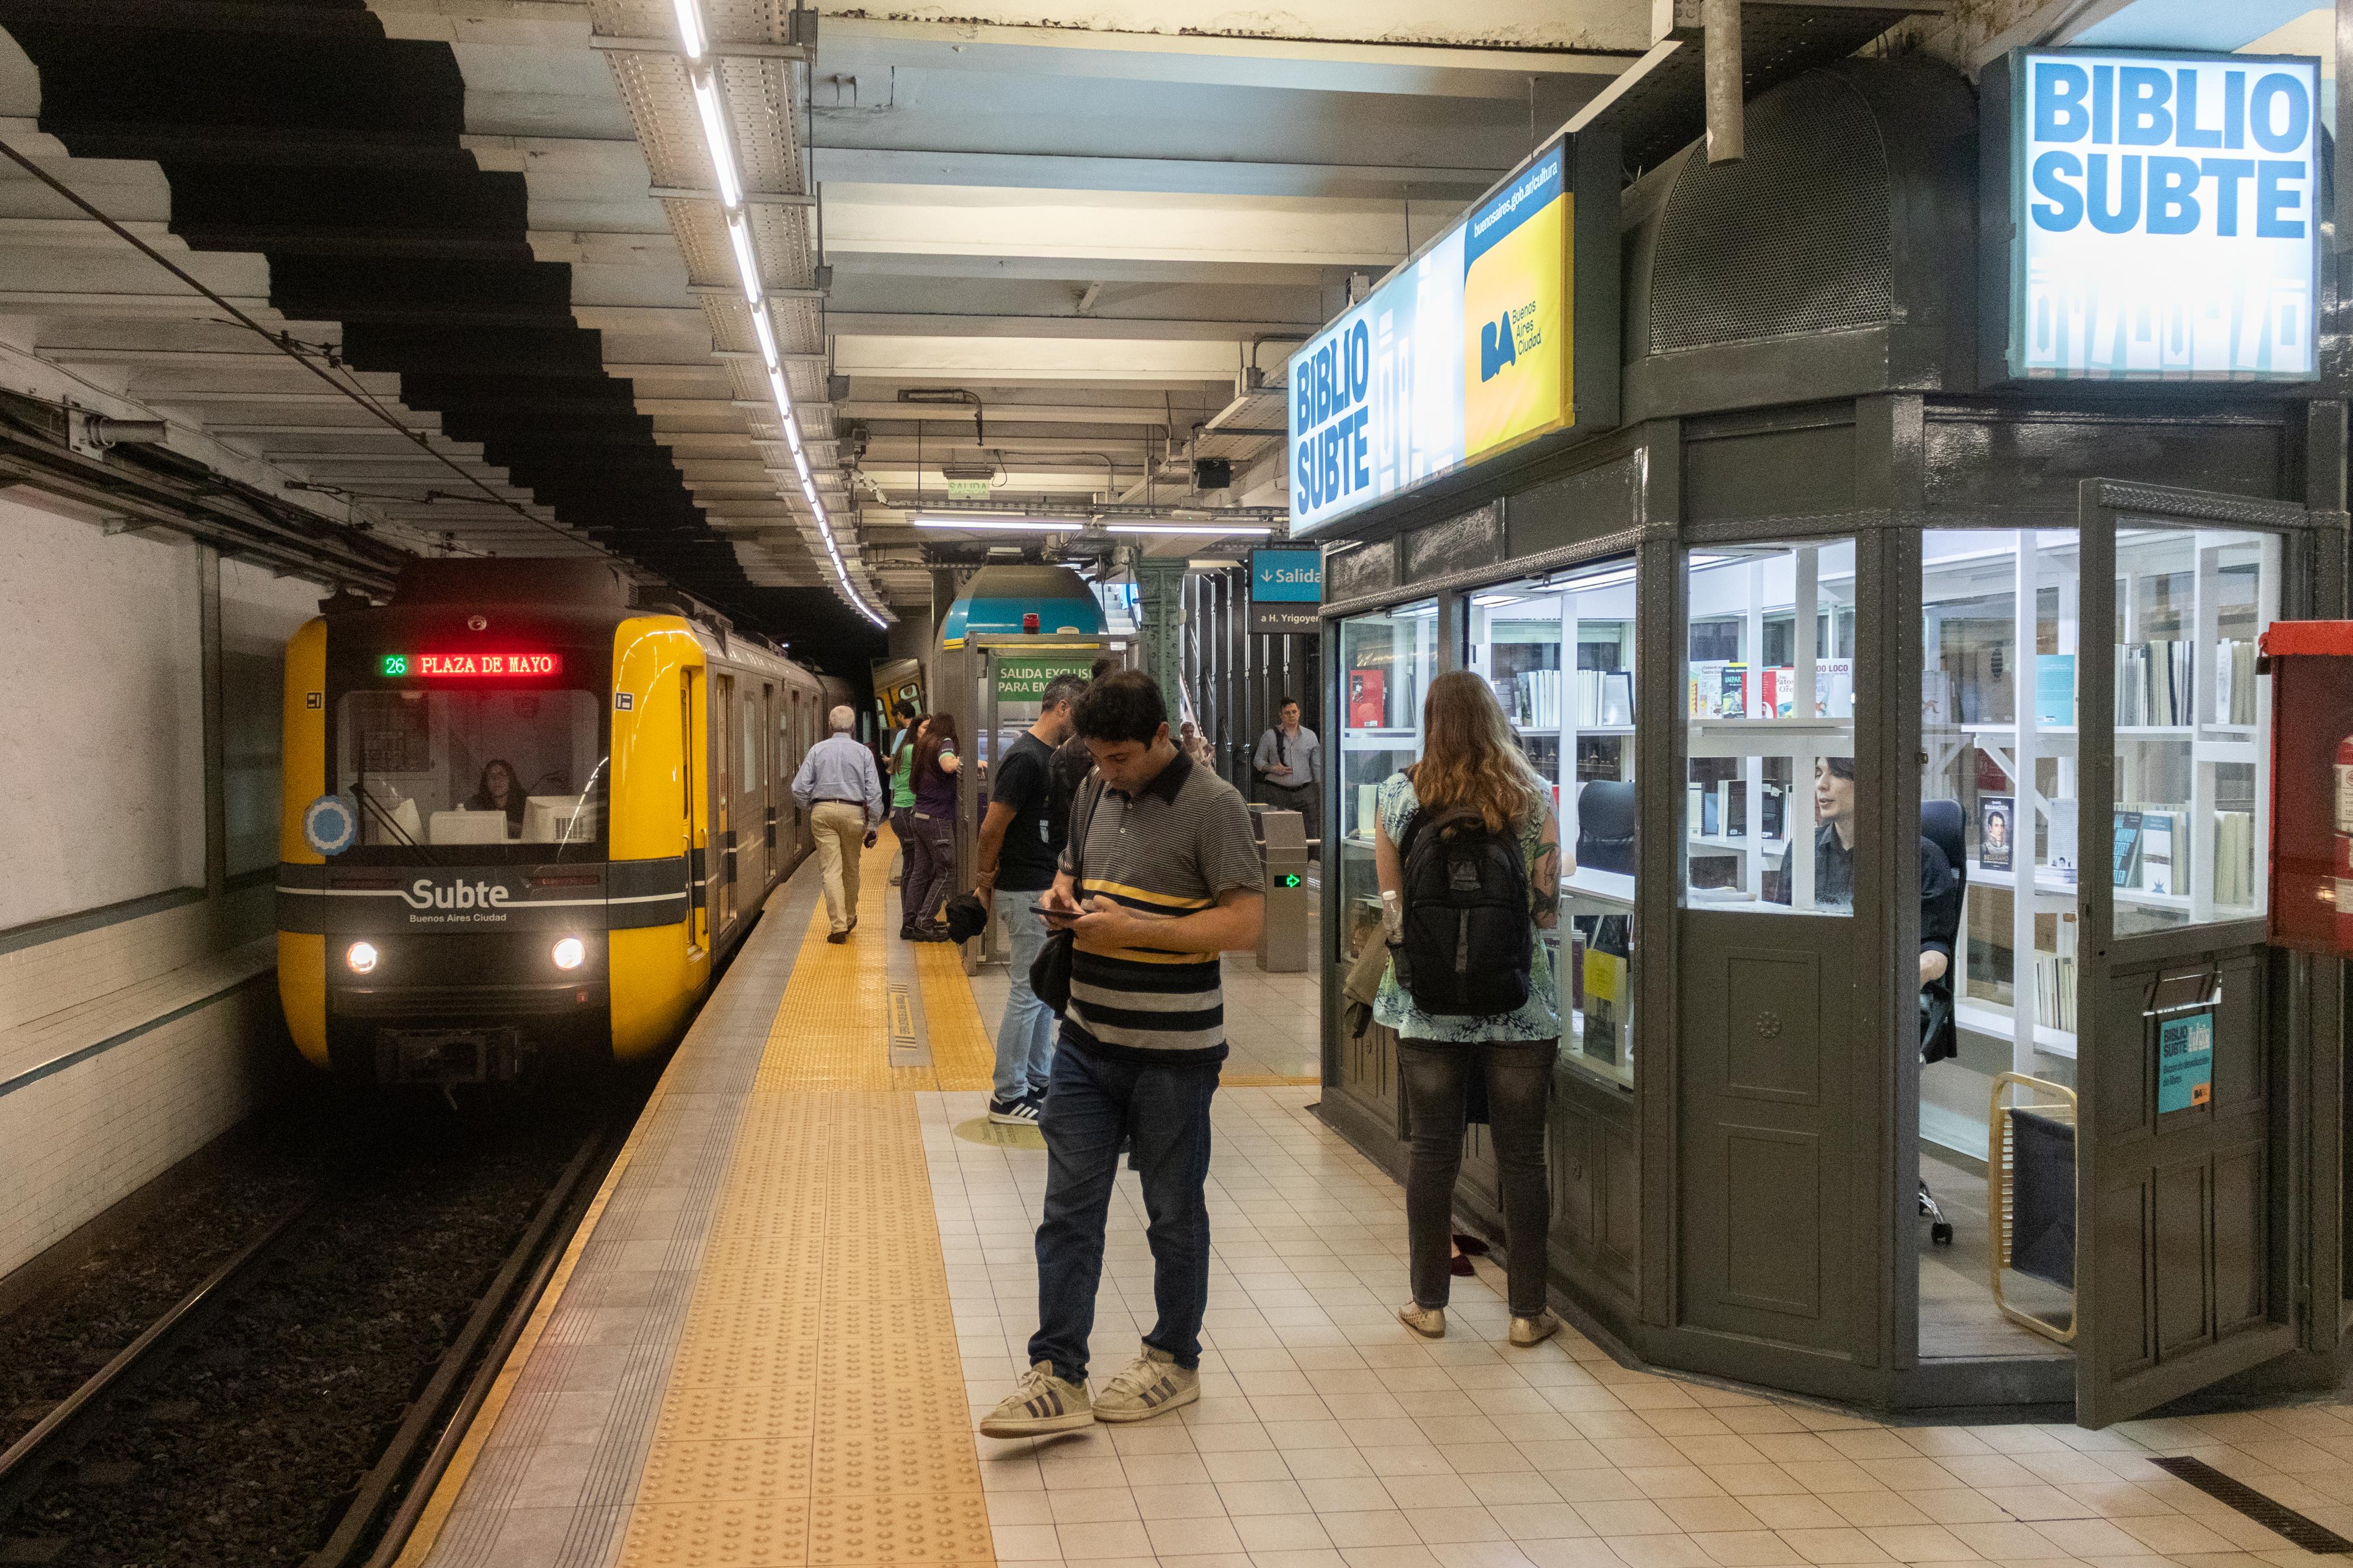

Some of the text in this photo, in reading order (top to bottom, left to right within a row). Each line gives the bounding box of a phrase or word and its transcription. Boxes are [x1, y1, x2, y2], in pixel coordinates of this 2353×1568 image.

[2034, 63, 2309, 153] BIBLIO
[1474, 162, 1558, 238] buenosaires.gob.ar/cultura
[2031, 150, 2306, 239] SUBTE
[1512, 300, 1536, 325] Buenos
[1516, 319, 1534, 340] Aires
[1518, 327, 1541, 356] Ciudad
[1297, 319, 1369, 438] BIBLIO
[1298, 405, 1369, 515] SUBTE
[950, 482, 988, 494] SALIDA
[1275, 568, 1321, 583] Salida
[386, 656, 552, 674] 26 PLAZA DE MAYO
[1000, 668, 1043, 679] SALIDA
[998, 682, 1029, 692] PARA
[413, 879, 510, 909] Subte
[410, 913, 507, 923] Buenos Aires Ciudad
[2164, 1025, 2188, 1043] BIBLIO
[2163, 1039, 2187, 1059] SUBTE
